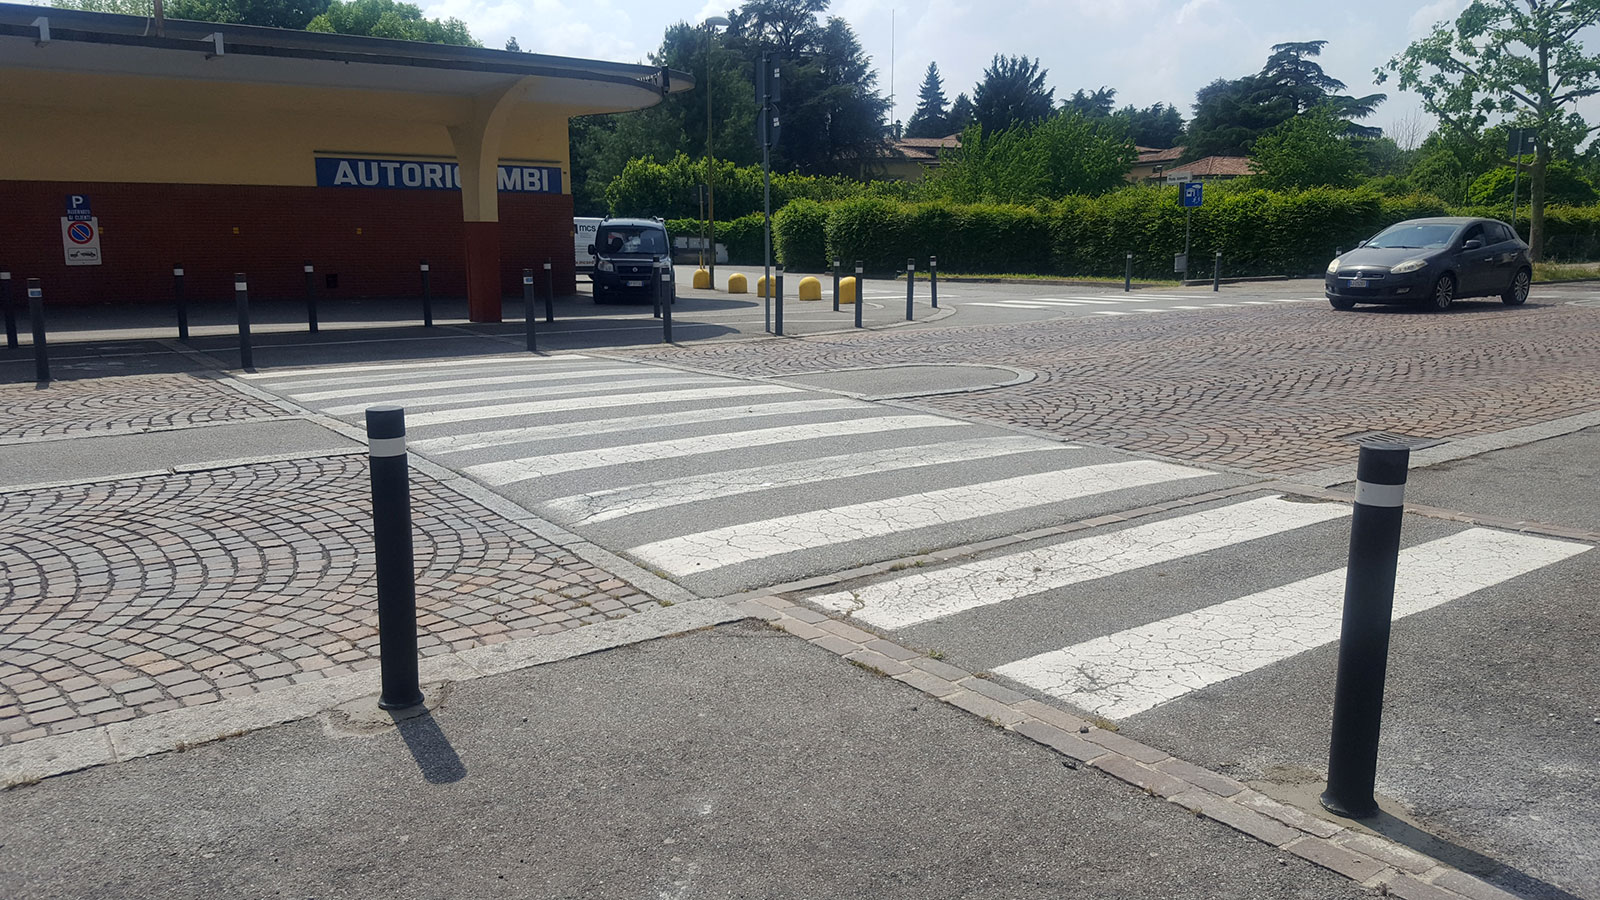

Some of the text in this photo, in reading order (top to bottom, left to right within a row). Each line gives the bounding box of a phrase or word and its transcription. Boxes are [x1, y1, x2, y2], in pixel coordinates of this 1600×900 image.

[333, 160, 549, 192] AUTORIMBI
[72, 196, 84, 208] P
[579, 224, 596, 232] mcs
